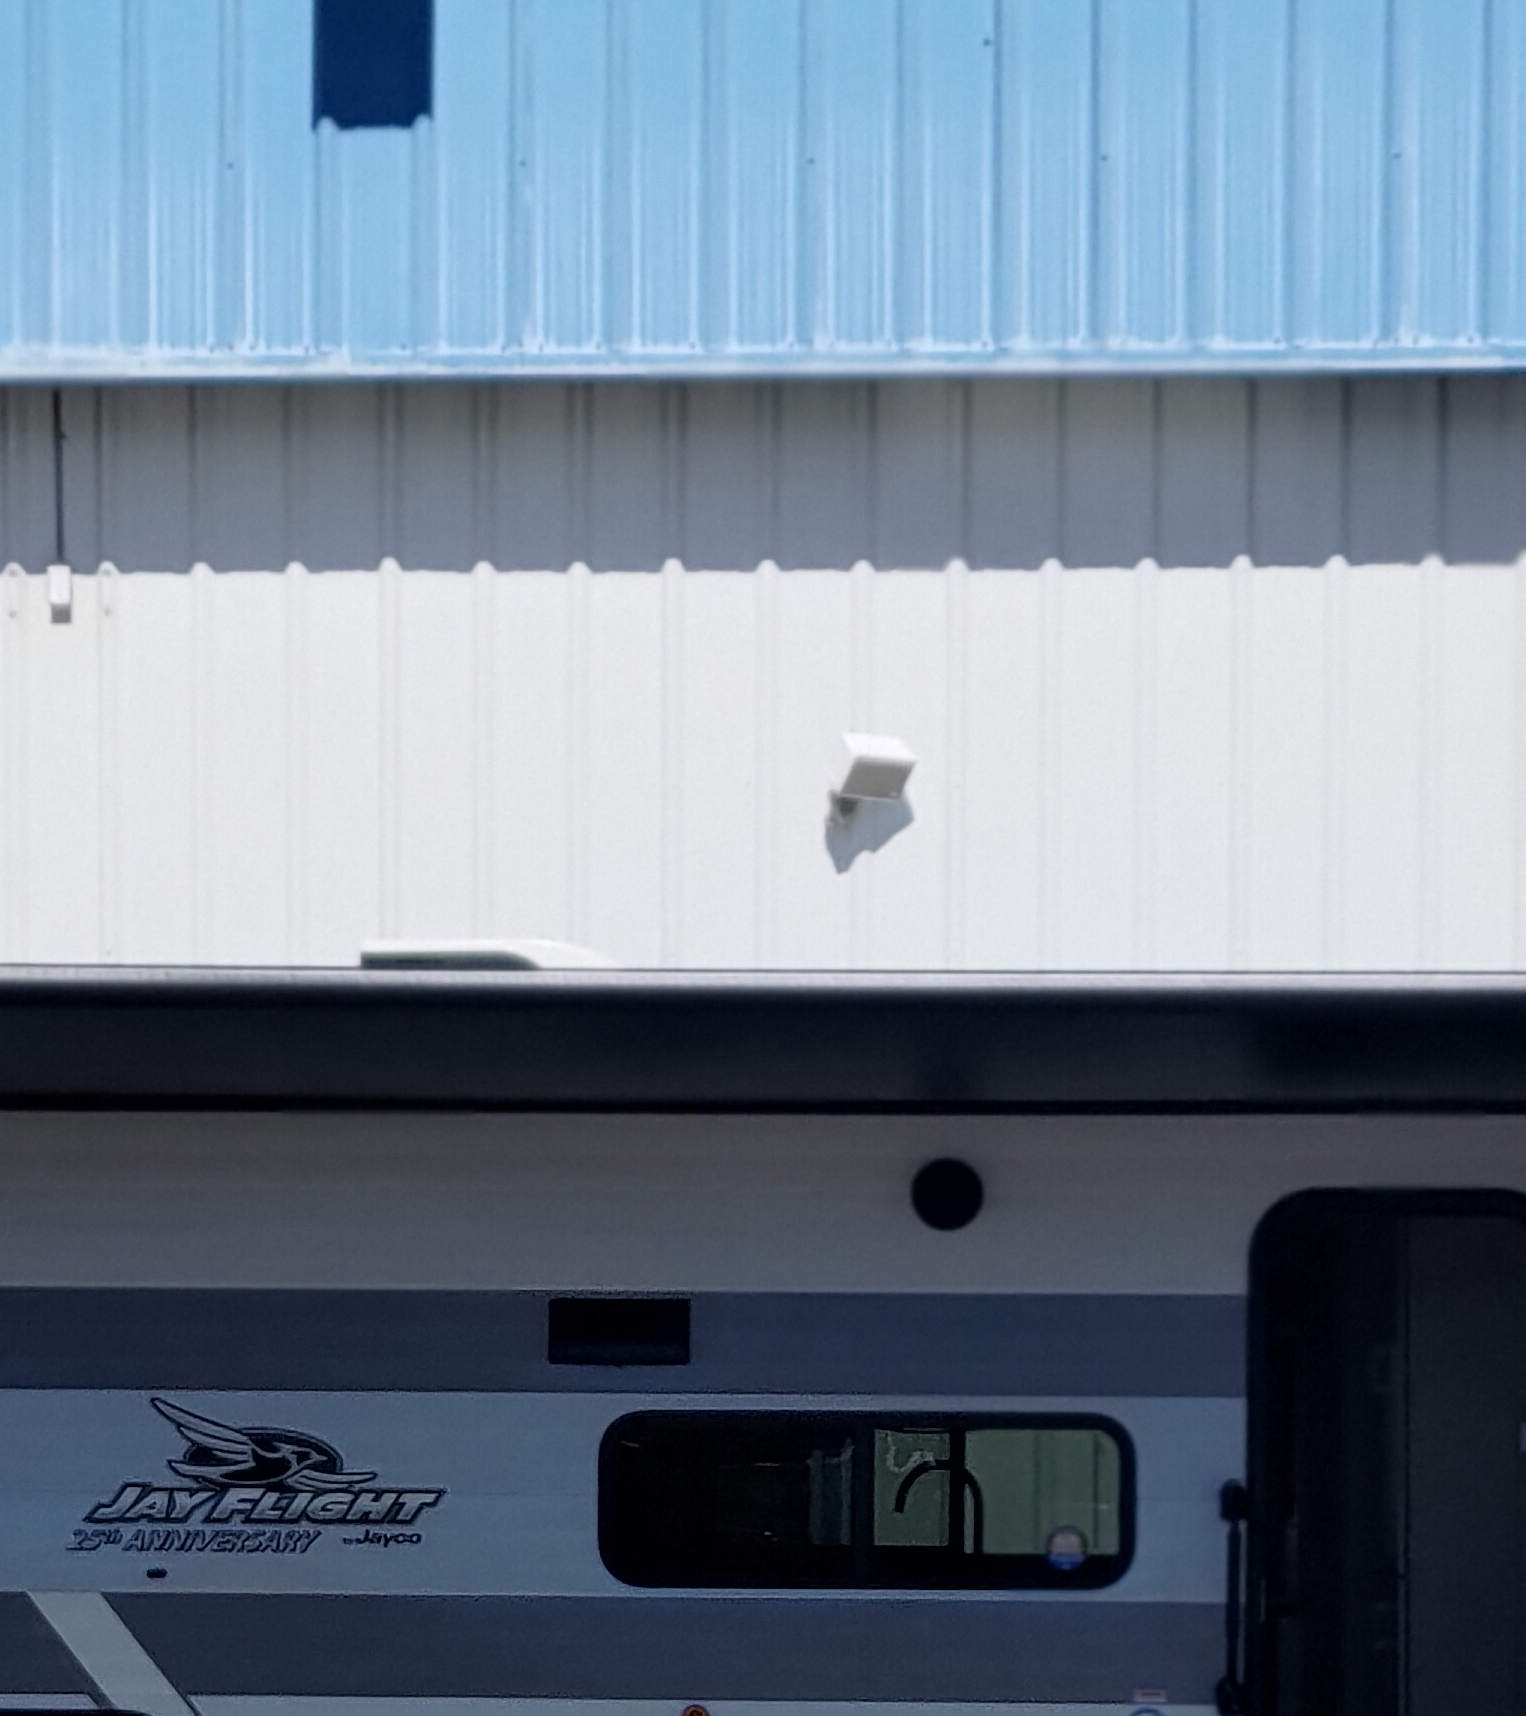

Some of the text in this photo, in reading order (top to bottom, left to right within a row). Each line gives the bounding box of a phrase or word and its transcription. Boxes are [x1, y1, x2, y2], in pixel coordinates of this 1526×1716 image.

[83, 1483, 448, 1523] JAY FLIGHT
[121, 1529, 321, 1553] ANNIVERSARY
